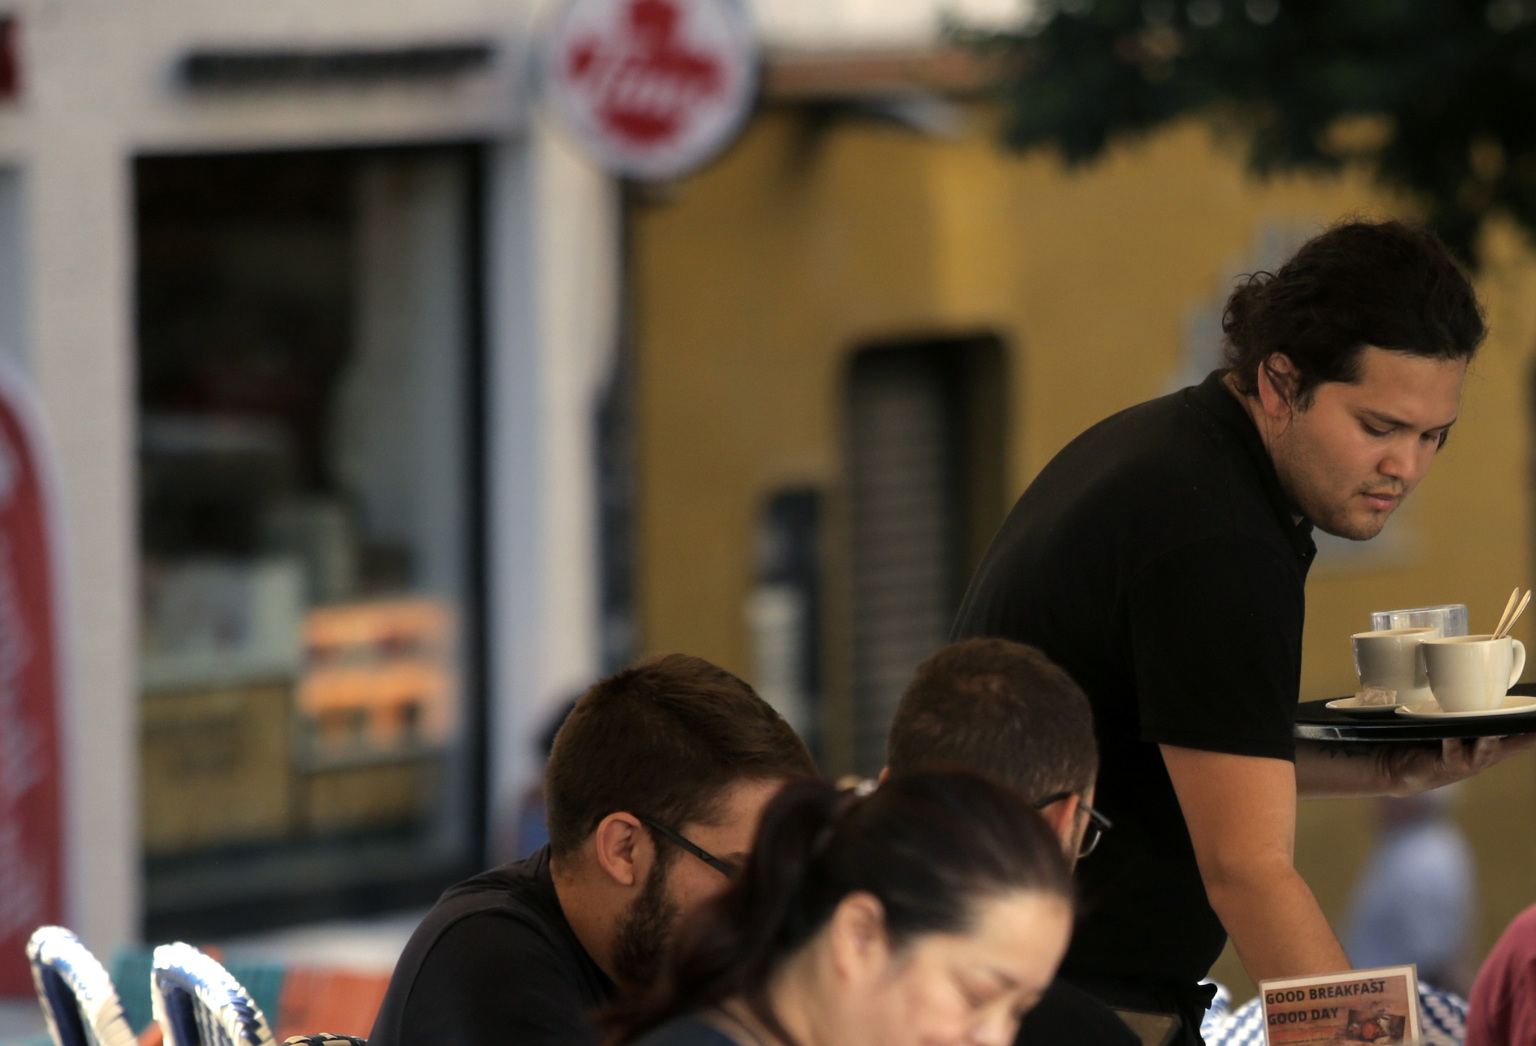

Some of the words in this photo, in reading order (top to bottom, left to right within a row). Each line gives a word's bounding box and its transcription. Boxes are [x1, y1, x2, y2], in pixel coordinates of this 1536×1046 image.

[1265, 990, 1305, 1005] GOOD
[1309, 980, 1386, 1000] BREAKFAST
[1267, 1010, 1307, 1025] GOOD
[1311, 1007, 1339, 1021] DAY
